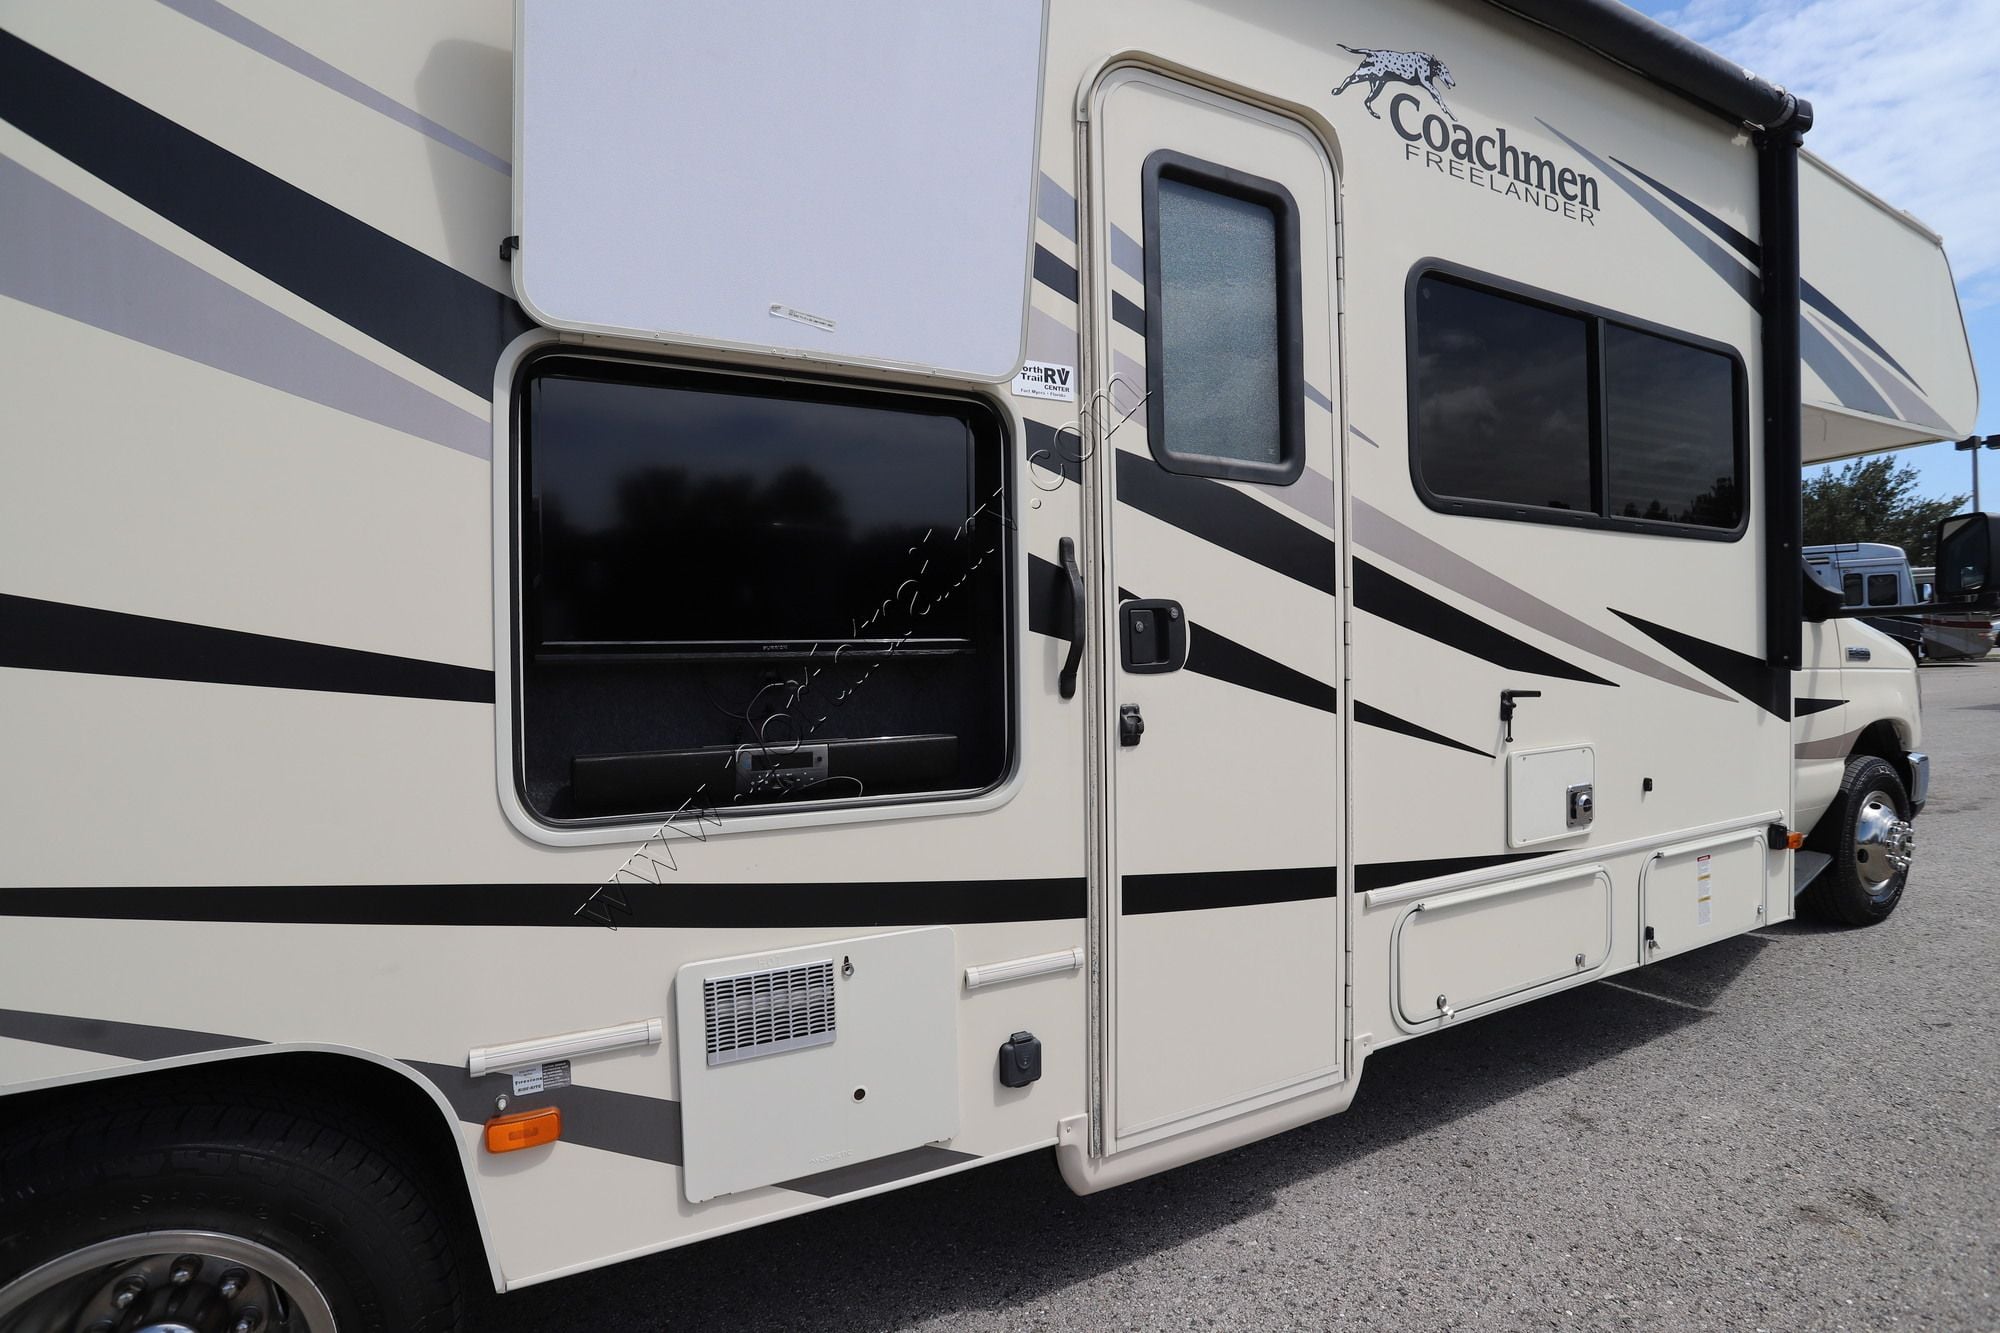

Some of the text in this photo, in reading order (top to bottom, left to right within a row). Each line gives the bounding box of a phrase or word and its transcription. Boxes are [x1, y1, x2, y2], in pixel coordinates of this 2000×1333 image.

[1389, 93, 1600, 211] Coachmen
[1405, 144, 1595, 226] FREELANDER
[1021, 372, 1043, 382] Trail
[1022, 366, 1043, 374] orth
[1044, 367, 1070, 385] RV
[1044, 384, 1070, 392] CENTER
